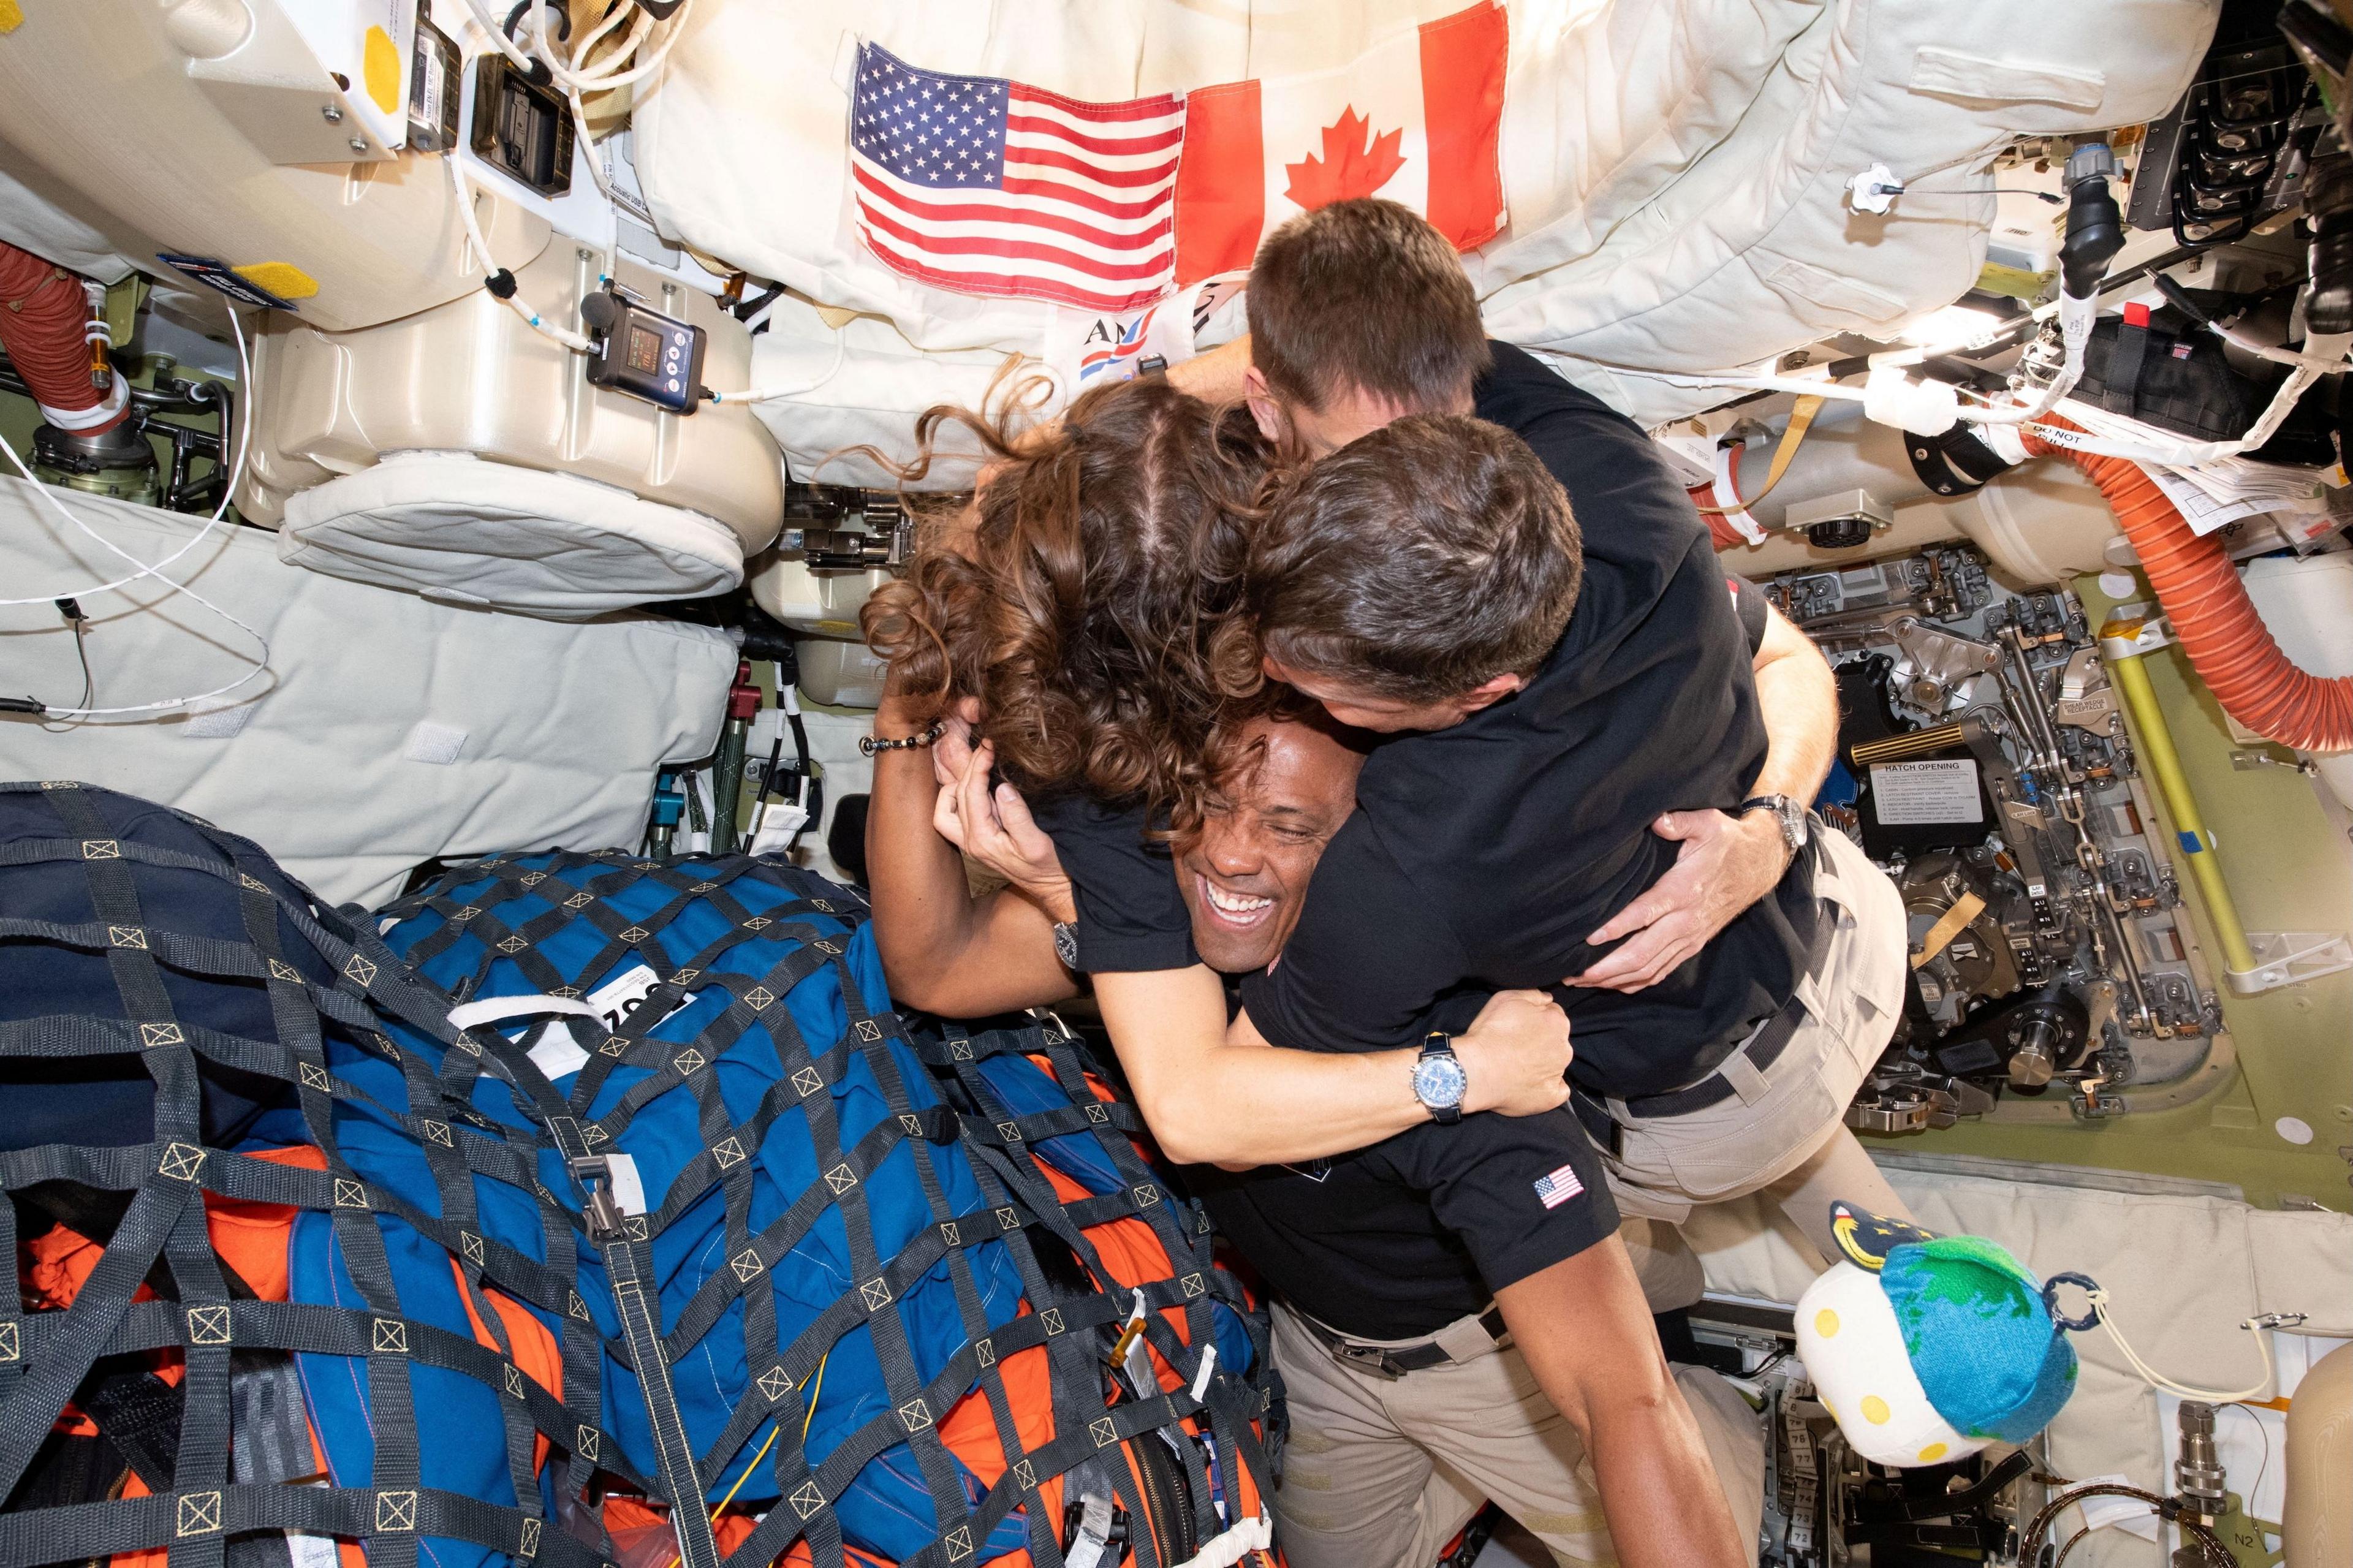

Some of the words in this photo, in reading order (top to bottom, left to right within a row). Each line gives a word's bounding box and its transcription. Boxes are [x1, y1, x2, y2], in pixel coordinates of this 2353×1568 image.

[610, 183, 631, 200] Acoustic
[631, 195, 642, 207] USB
[2055, 431, 2082, 444] NOT
[2067, 704, 2104, 713] RECEPTACLE
[1795, 1385, 1806, 1396] 81
[1792, 1434, 1805, 1443] 78
[1796, 1454, 1811, 1463] 77
[1797, 1513, 1809, 1523] 73
[1794, 1533, 1808, 1543] 72
[2235, 1533, 2253, 1548] N2
